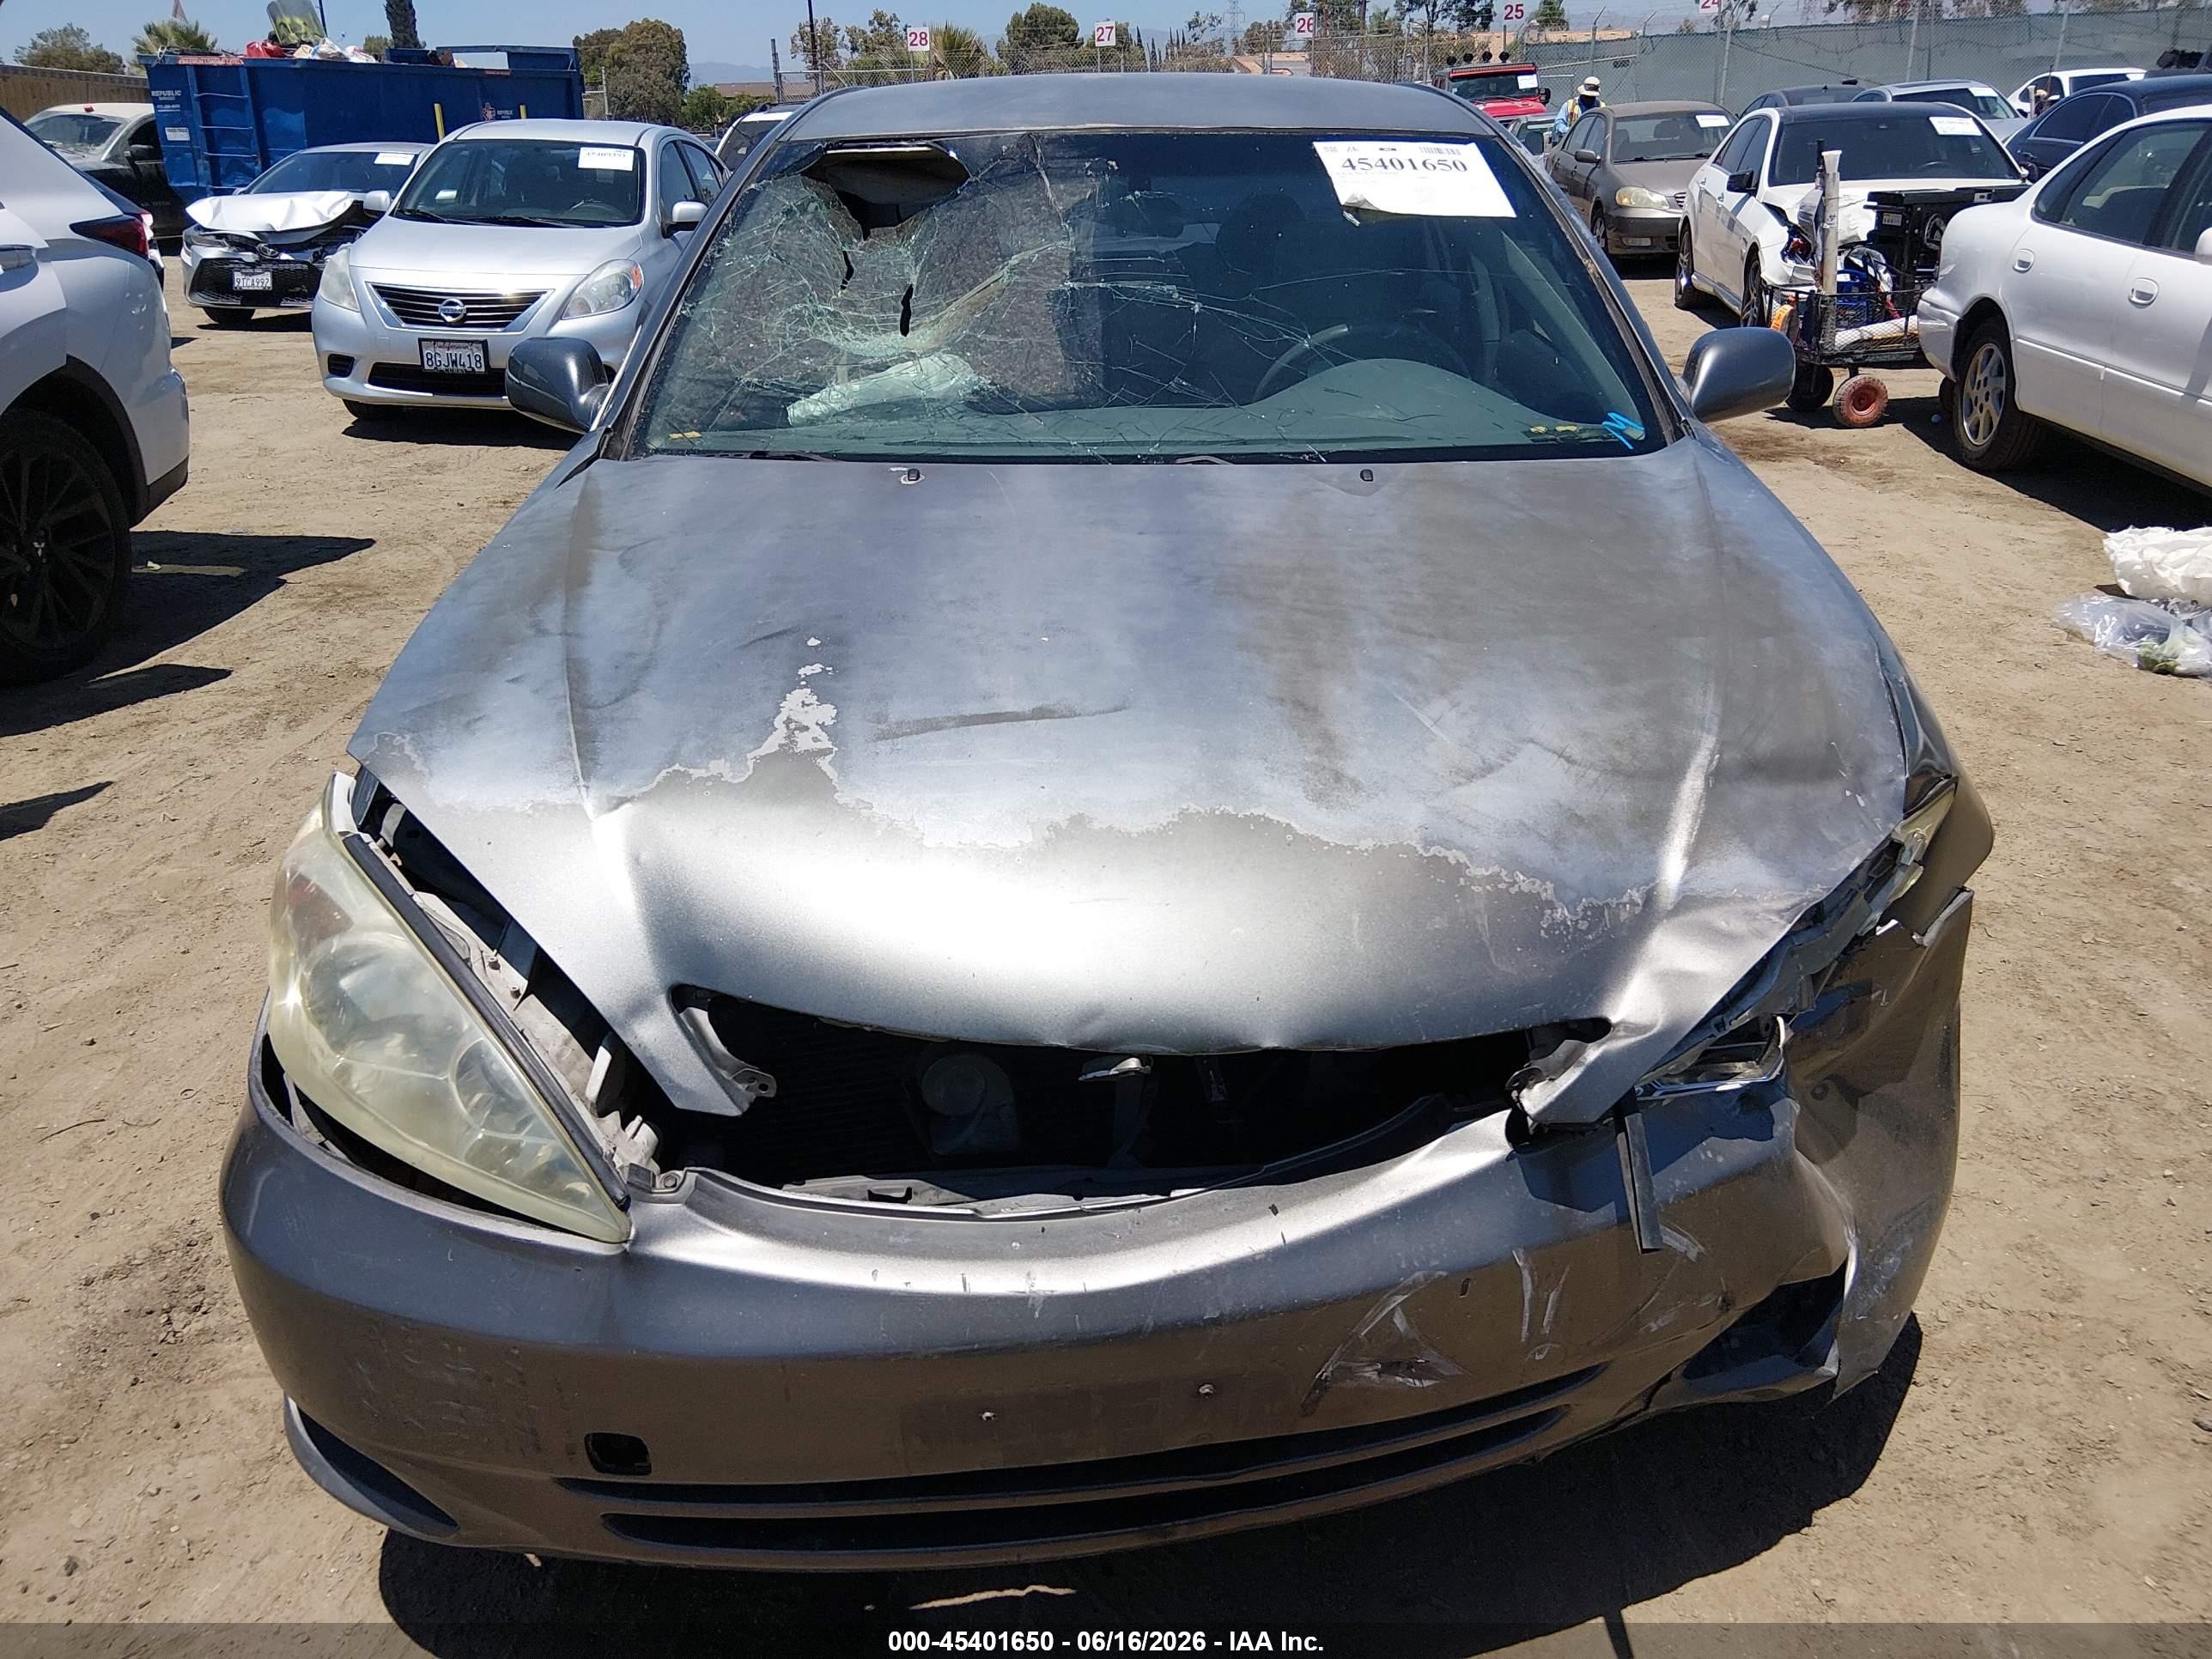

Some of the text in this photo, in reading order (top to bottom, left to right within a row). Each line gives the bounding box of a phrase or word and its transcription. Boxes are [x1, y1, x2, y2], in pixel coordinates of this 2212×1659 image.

[1504, 3, 1524, 20] 25
[1297, 17, 1313, 33] 26
[908, 31, 928, 46] 28
[1096, 26, 1114, 42] 27
[1341, 157, 1468, 172] 45401650
[425, 351, 483, 369] 8GJW418
